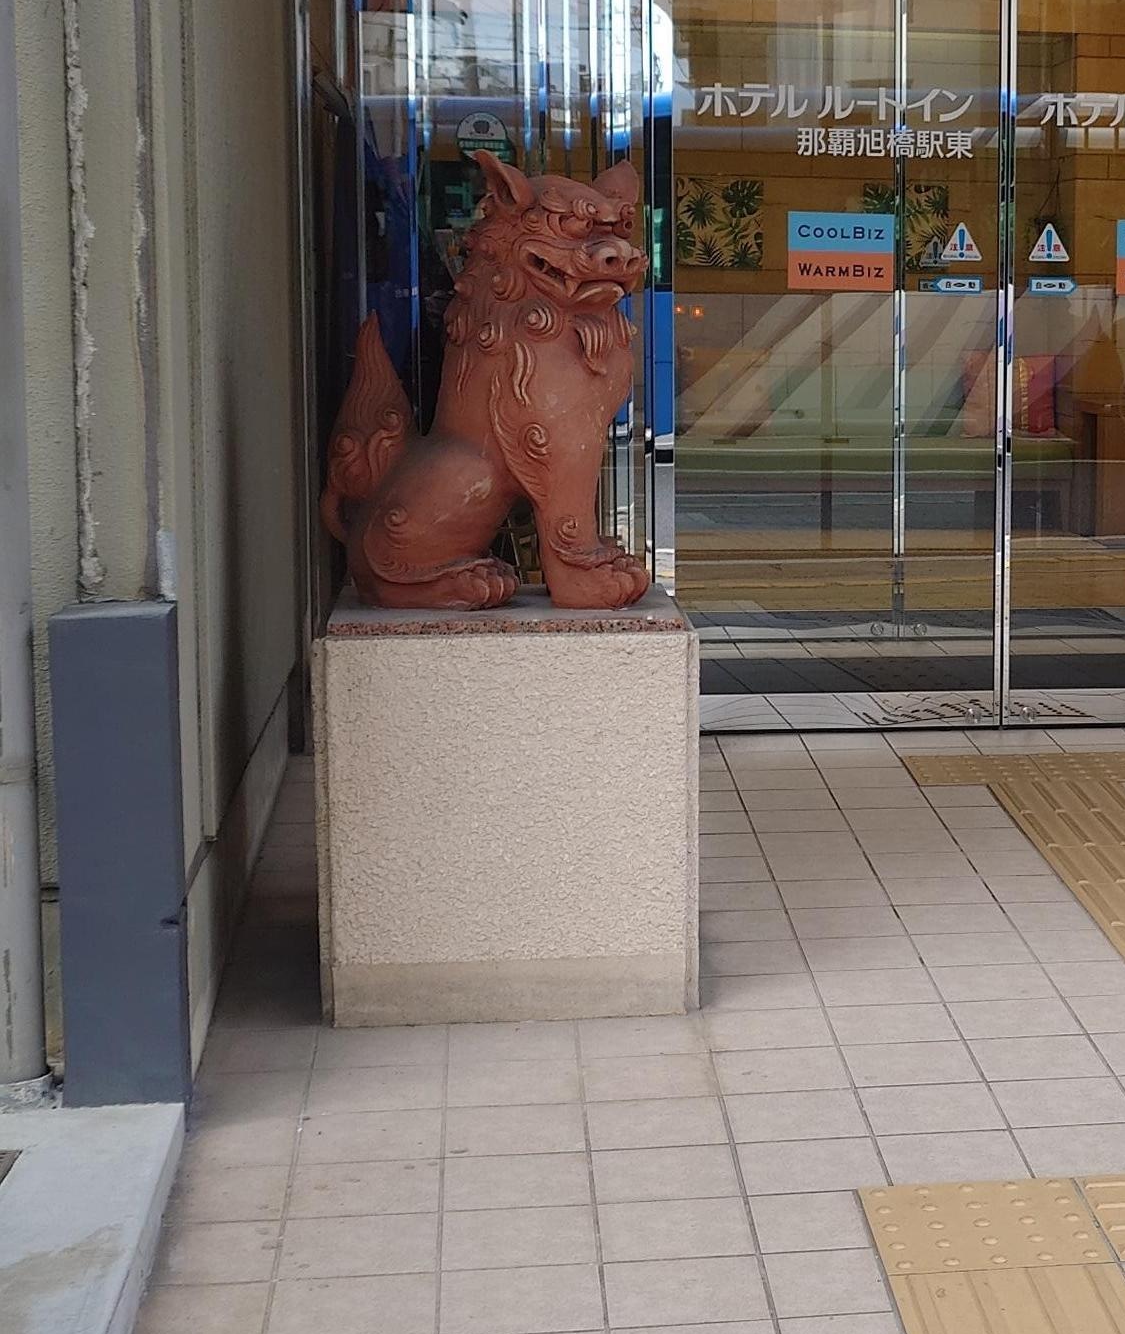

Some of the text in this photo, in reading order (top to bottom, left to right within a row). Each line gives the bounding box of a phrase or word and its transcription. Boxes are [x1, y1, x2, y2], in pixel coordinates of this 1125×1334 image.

[697, 82, 974, 123] ホテル ルートイン
[796, 127, 975, 160] 那覇旭橋駅東
